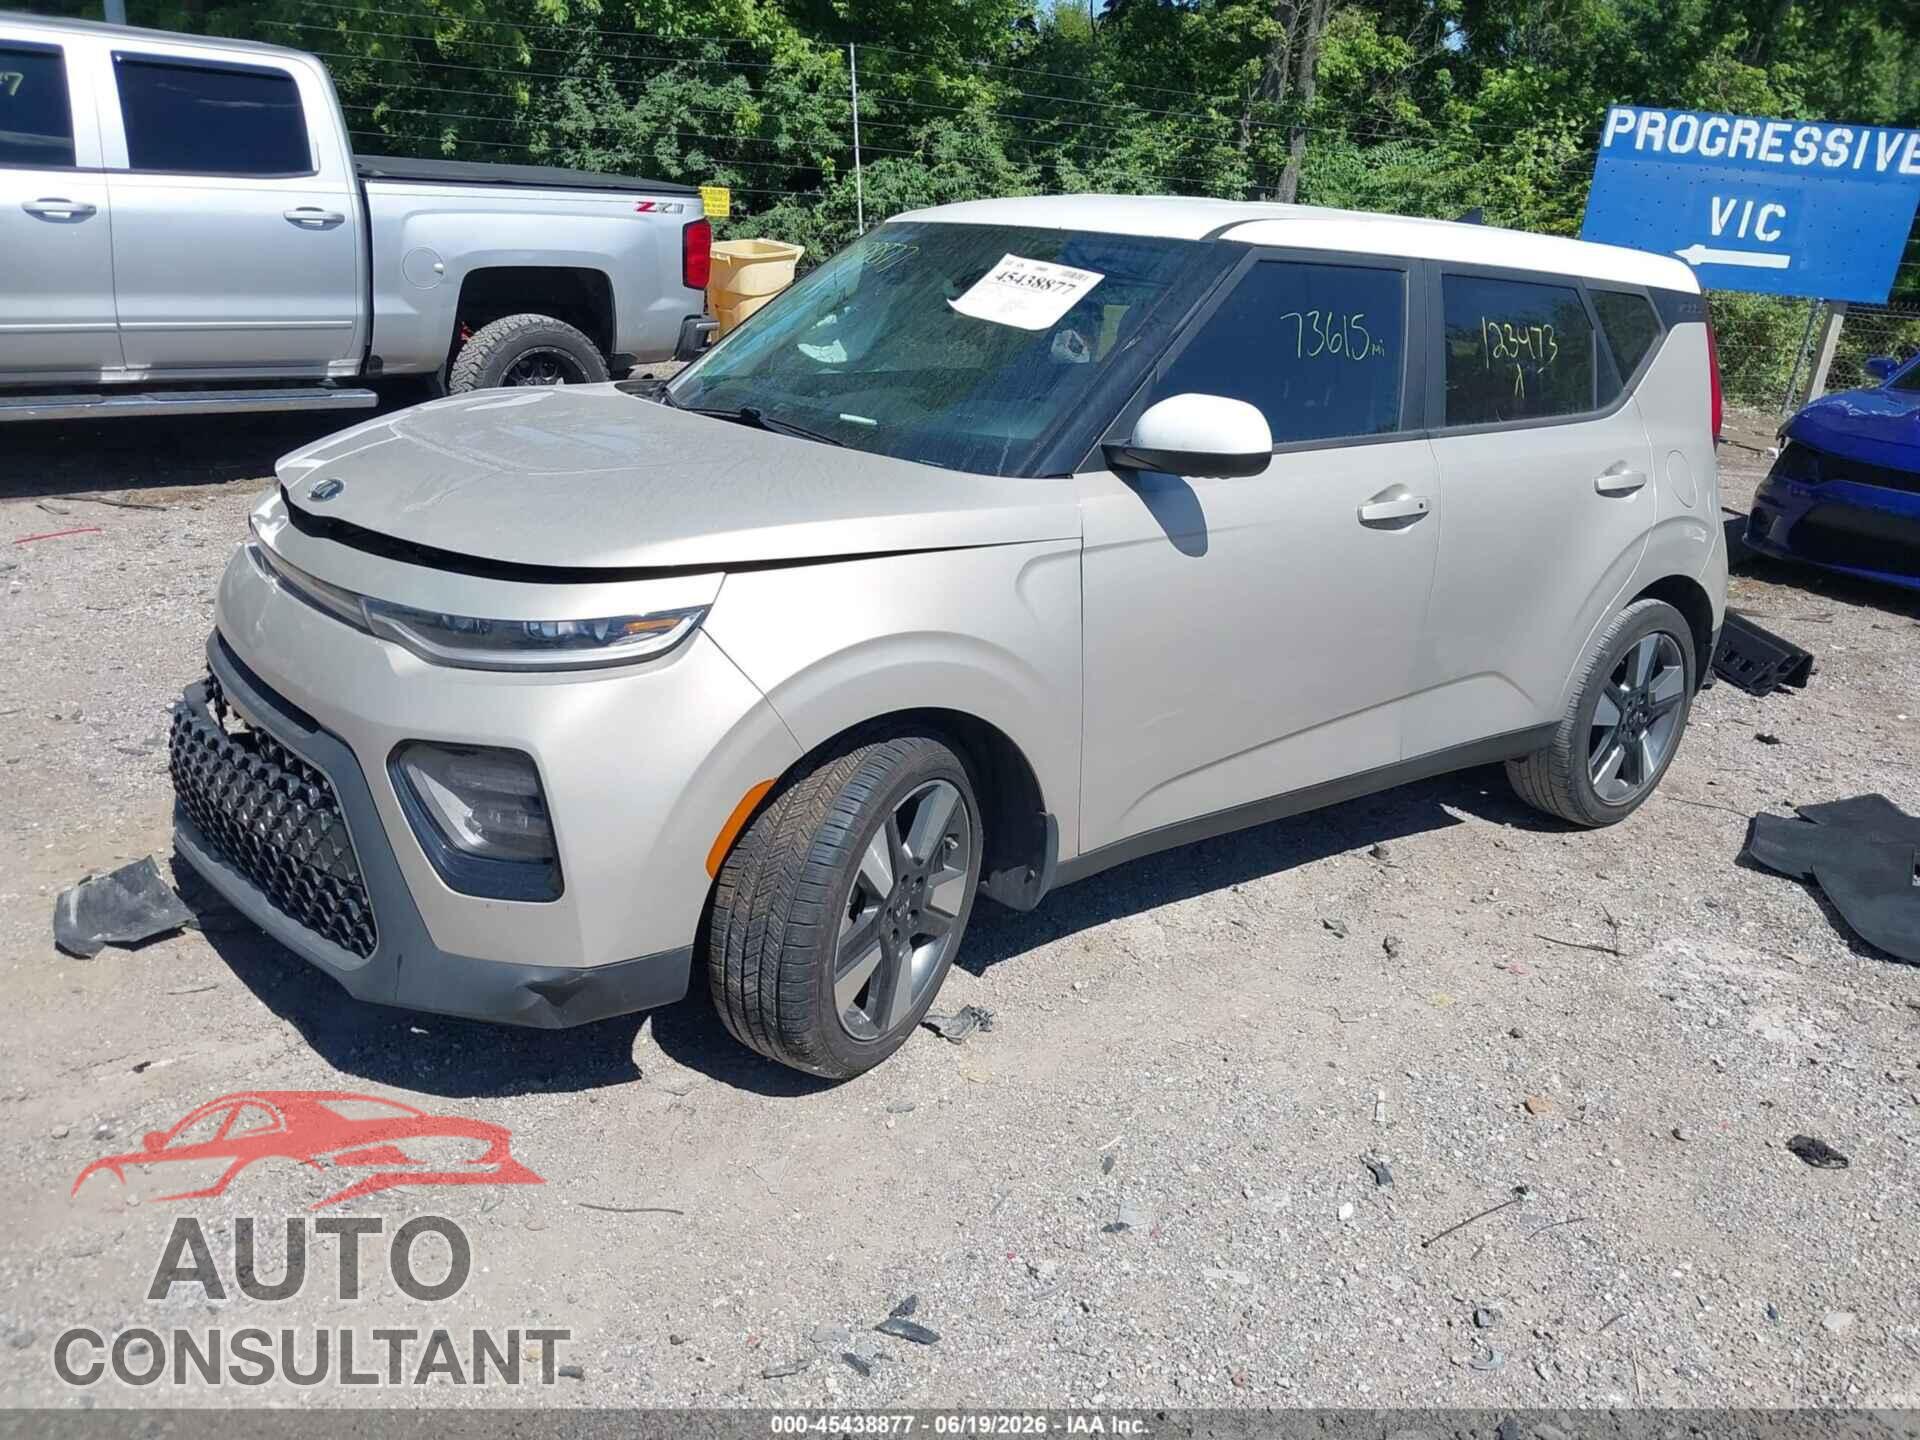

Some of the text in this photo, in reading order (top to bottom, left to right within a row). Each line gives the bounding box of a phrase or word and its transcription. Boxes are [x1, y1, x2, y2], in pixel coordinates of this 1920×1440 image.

[1603, 108, 1920, 174] PROGRESSIVE
[1711, 196, 1786, 242] VIC
[996, 271, 1077, 295] 45438877
[1280, 310, 1370, 361] 73615
